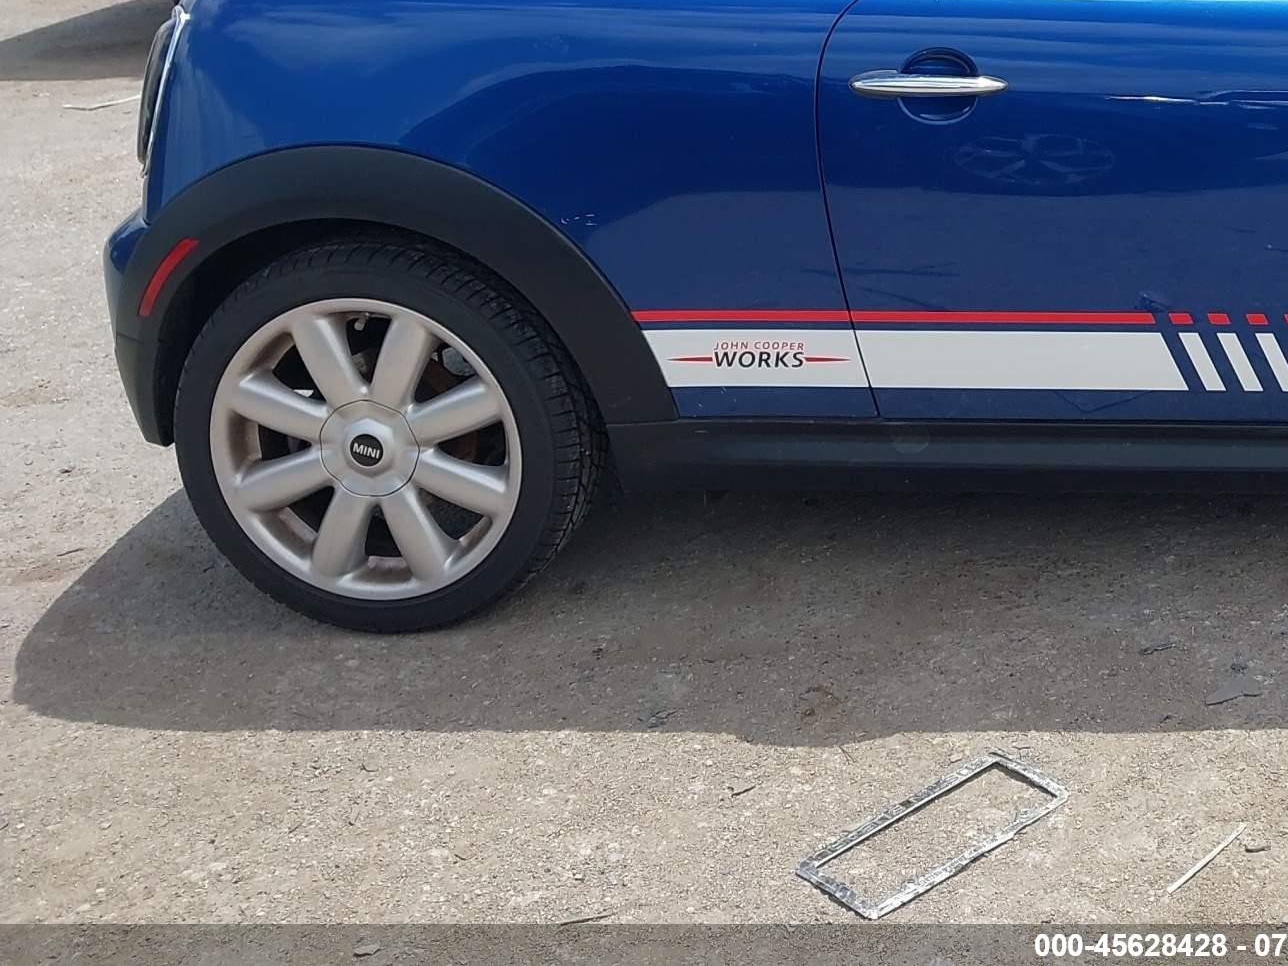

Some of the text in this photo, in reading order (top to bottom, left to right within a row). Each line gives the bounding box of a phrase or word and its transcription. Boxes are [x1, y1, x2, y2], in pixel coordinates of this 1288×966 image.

[713, 340, 805, 351] JOHN COOPER
[714, 351, 805, 368] WORKS
[352, 442, 381, 459] MINI
